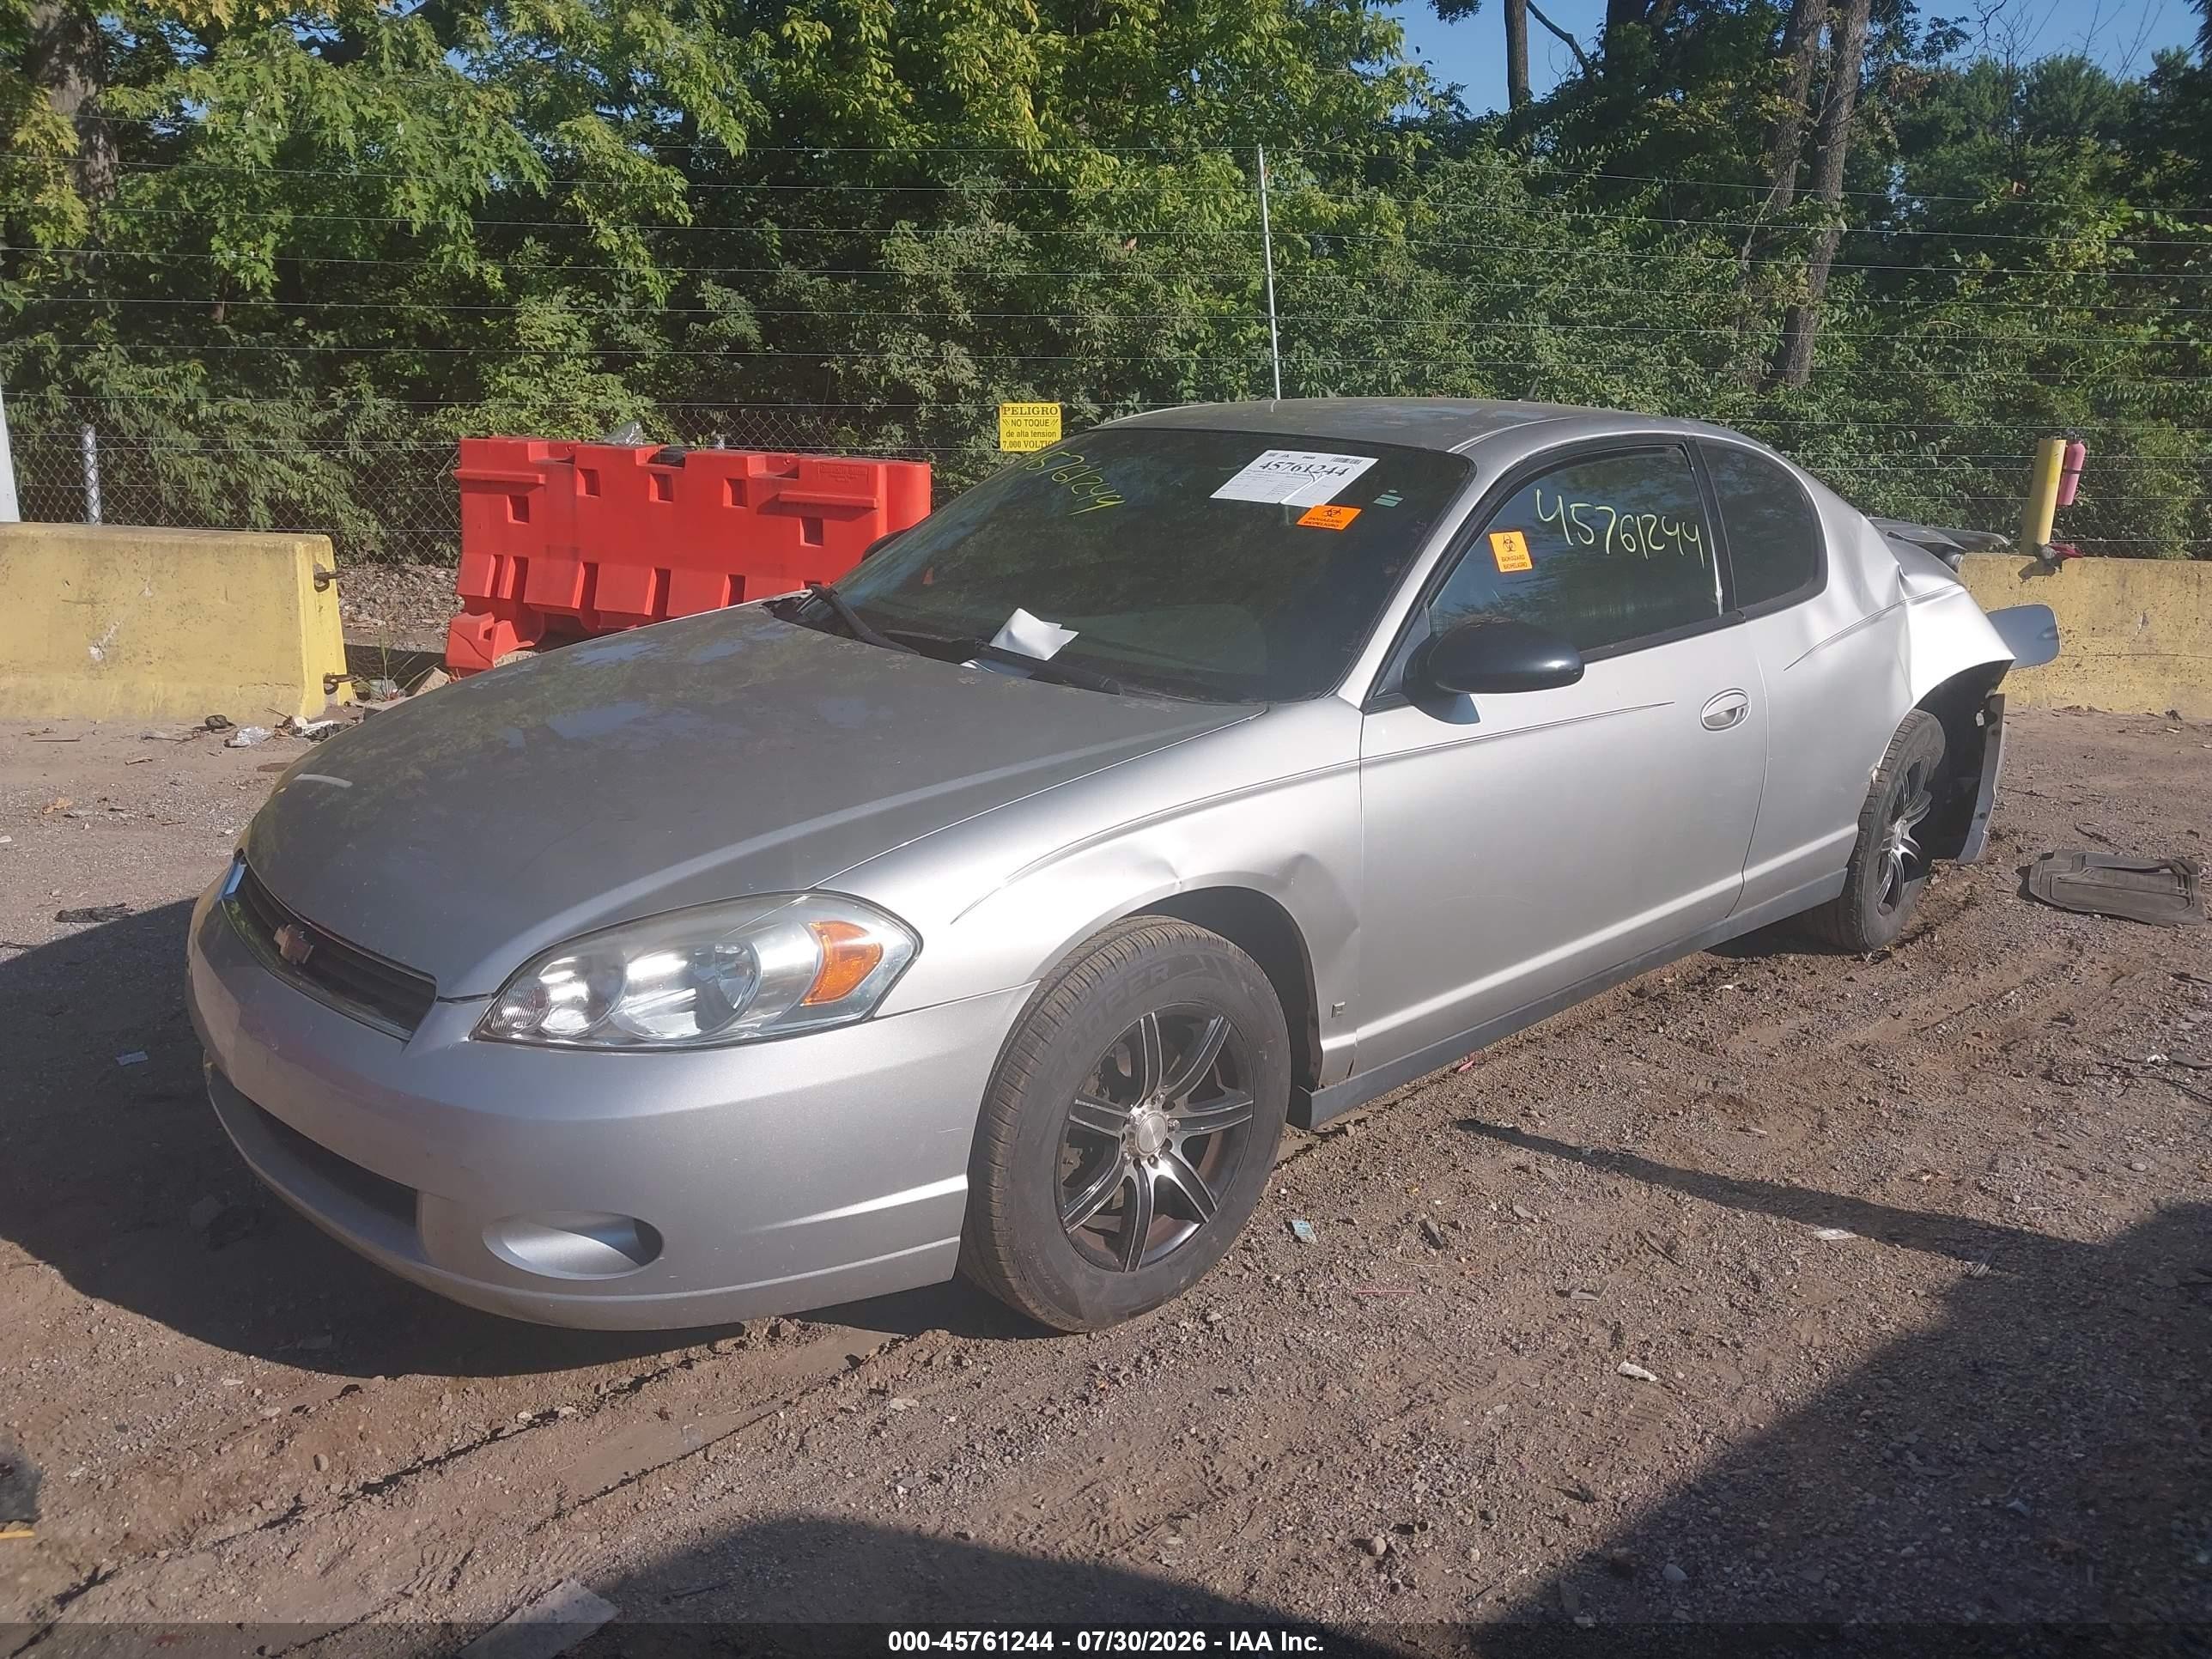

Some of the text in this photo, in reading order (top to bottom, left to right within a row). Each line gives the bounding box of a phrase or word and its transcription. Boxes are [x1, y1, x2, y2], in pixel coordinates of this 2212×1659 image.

[1003, 406, 1058, 416] PELIGRO
[1003, 441, 1022, 449] 7,000
[1259, 460, 1350, 477] 45761244
[1534, 489, 1705, 569] 45761244
